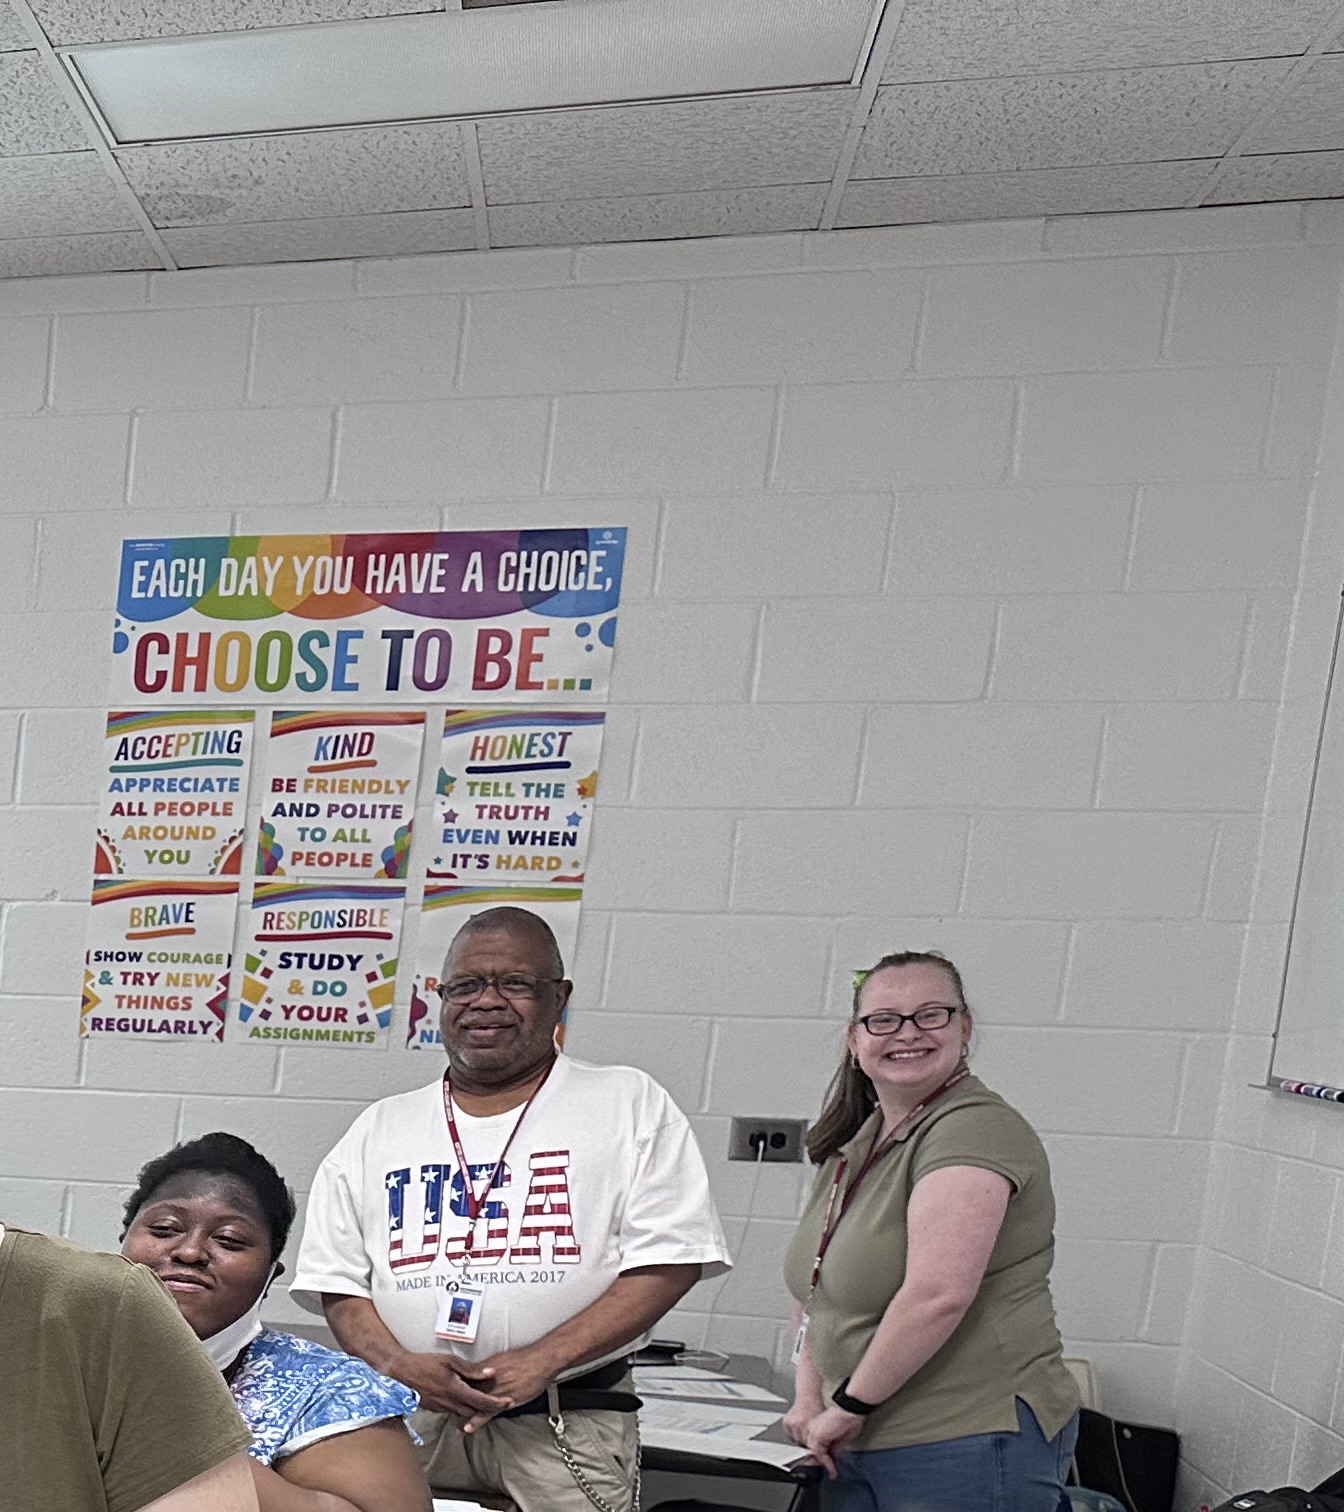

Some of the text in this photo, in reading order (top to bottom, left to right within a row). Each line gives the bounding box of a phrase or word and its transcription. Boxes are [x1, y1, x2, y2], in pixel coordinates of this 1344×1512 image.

[131, 549, 612, 598] EACH DAY YOU HAVE A CHOICE,
[133, 627, 592, 692] CHOOSE TO BE...
[115, 729, 242, 762] ACCEPTING
[314, 731, 374, 761] KIND
[469, 730, 573, 762] HONEST
[109, 776, 240, 794] APPRECIATE
[271, 777, 410, 794] BE FRIENDLY
[466, 782, 565, 798] TELL THE
[109, 800, 234, 817] ALL PEOPLE
[271, 803, 403, 819] AND POLITE
[475, 804, 550, 821] TRUTH
[122, 824, 217, 841] AROUND
[297, 827, 372, 843] TO ALL
[442, 829, 577, 846] EVEN WHEN
[143, 849, 191, 866] YOU
[291, 851, 373, 868] PEOPLE
[451, 854, 562, 871] IT'S HARD
[129, 903, 196, 929] BRAVE
[262, 908, 390, 931] RESPONSIBLE
[93, 950, 224, 965] SHOW COURAGE
[278, 953, 363, 971] STUDY
[98, 971, 214, 987] & TRY NEW
[288, 979, 347, 995] & DO
[115, 995, 192, 1011] THINGS
[281, 1005, 348, 1022] YOUR
[90, 1018, 212, 1035] REGULARLY
[248, 1027, 375, 1043] ASSIGNMENTS
[385, 1149, 581, 1276] USA
[396, 1277, 432, 1293] MADE
[530, 1270, 567, 1285] 2017
